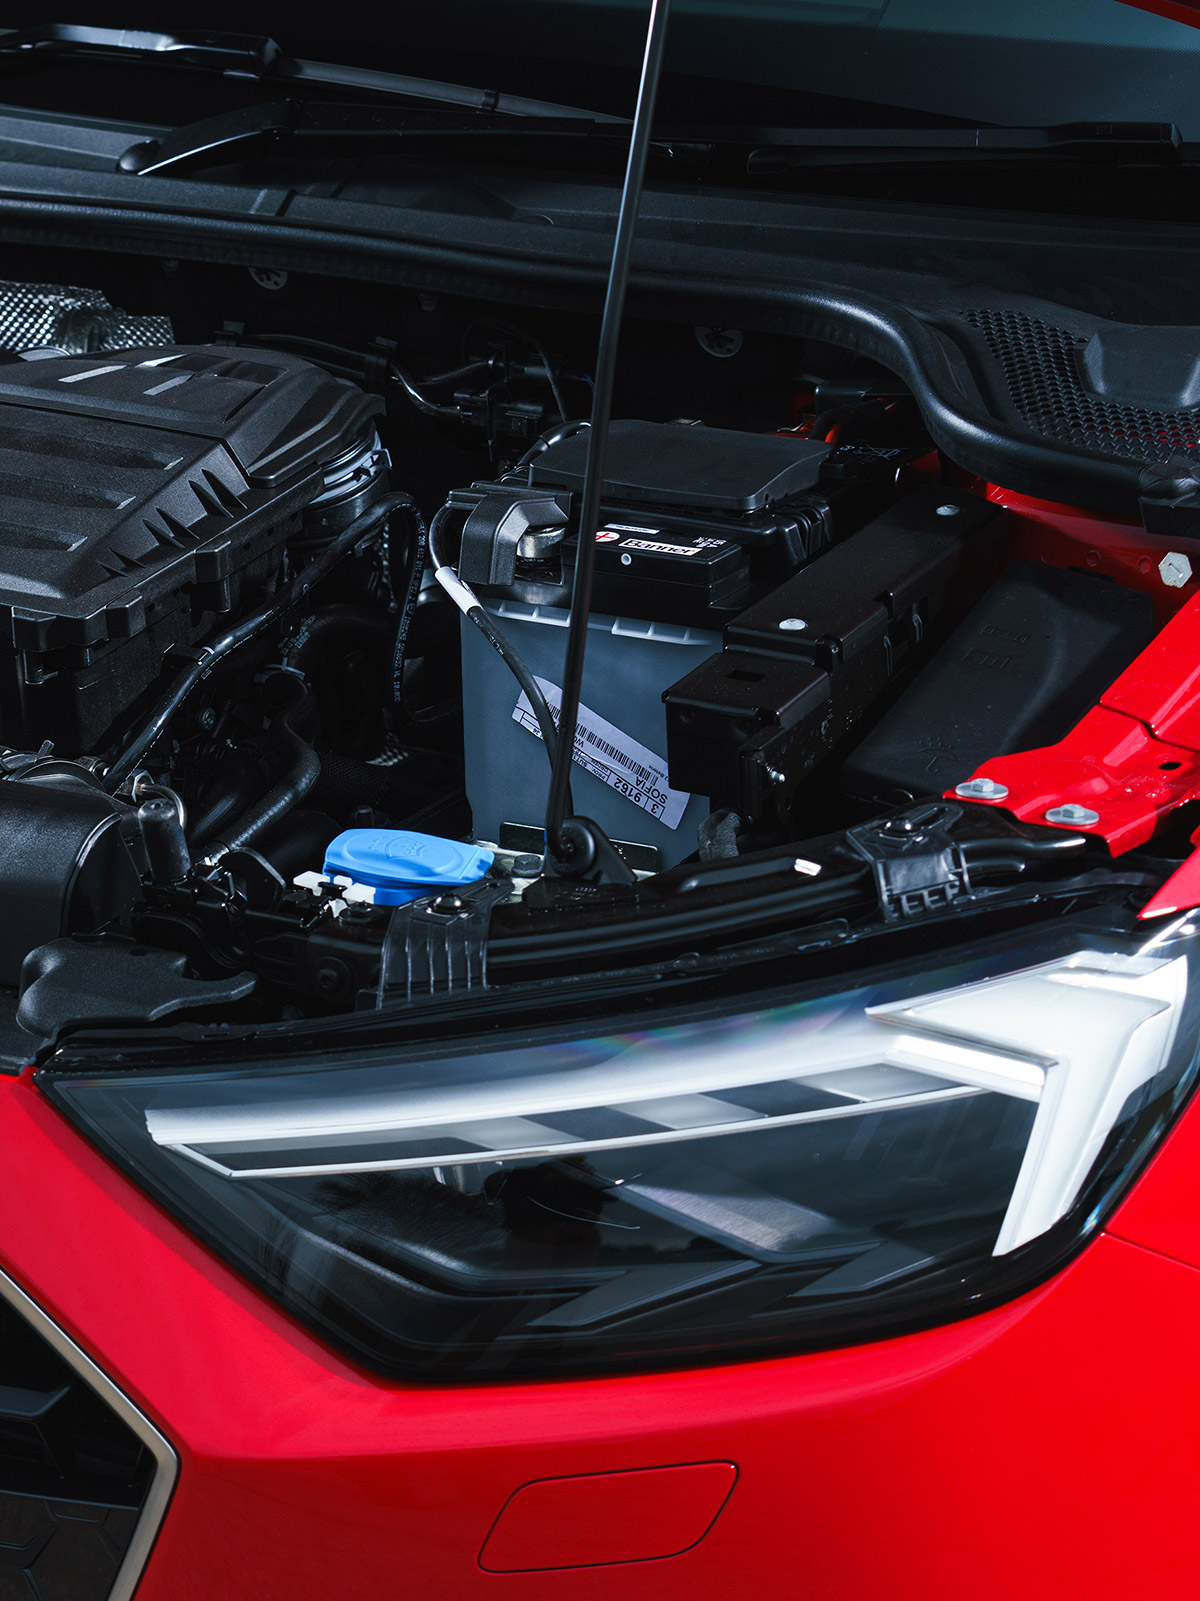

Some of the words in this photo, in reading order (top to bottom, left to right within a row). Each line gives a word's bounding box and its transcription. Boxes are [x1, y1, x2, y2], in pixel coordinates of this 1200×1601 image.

[624, 540, 692, 554] Banner
[613, 777, 642, 803] 9162
[635, 776, 668, 804] SOFIA
[650, 804, 659, 814] 3
